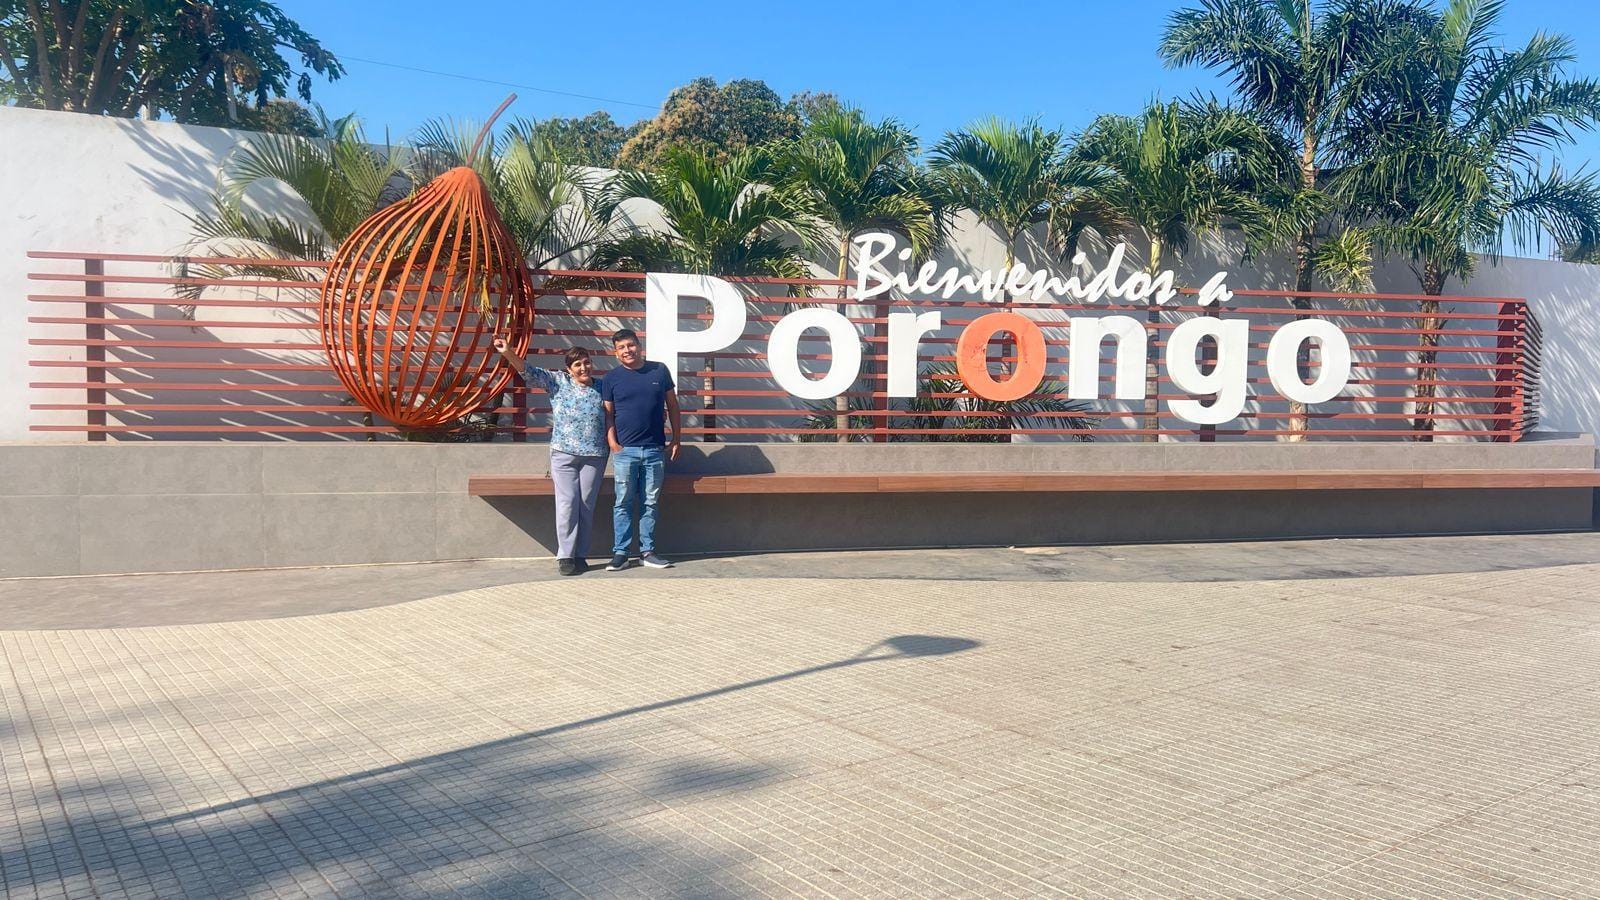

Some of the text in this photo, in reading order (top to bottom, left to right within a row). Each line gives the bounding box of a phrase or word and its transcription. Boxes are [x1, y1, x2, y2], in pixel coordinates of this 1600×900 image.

[853, 231, 1234, 306] Bienvenidos a
[645, 271, 1352, 424] Porongo
